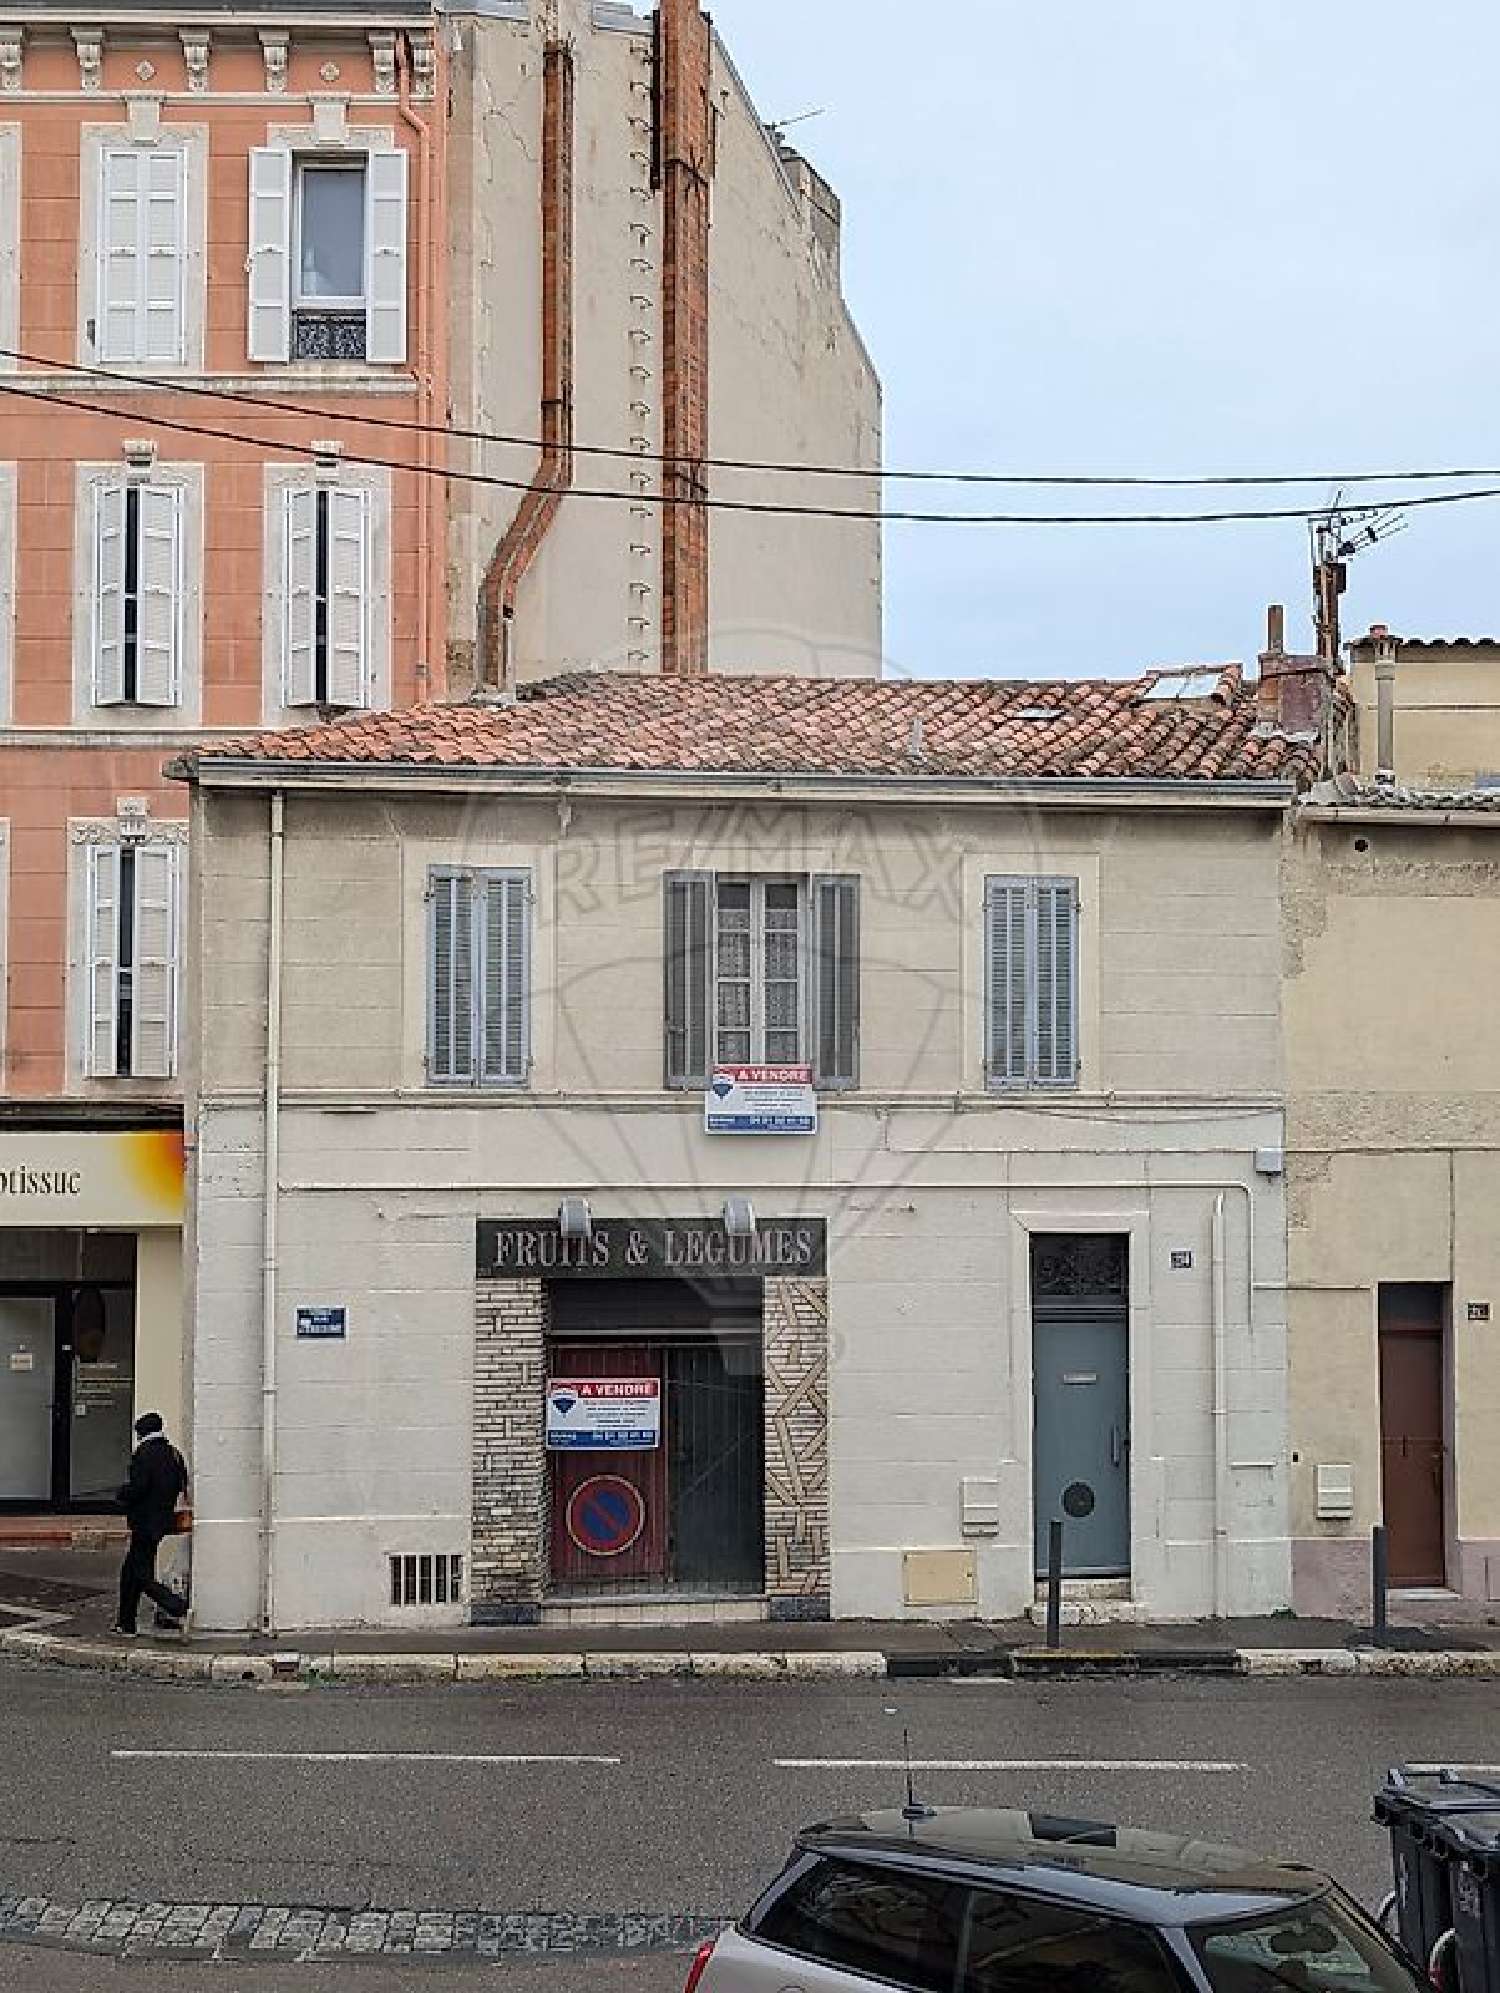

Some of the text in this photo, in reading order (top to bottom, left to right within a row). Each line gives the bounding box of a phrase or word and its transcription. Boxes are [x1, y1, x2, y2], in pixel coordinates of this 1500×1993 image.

[493, 1230, 815, 1267] FRUITS & LEGUMES
